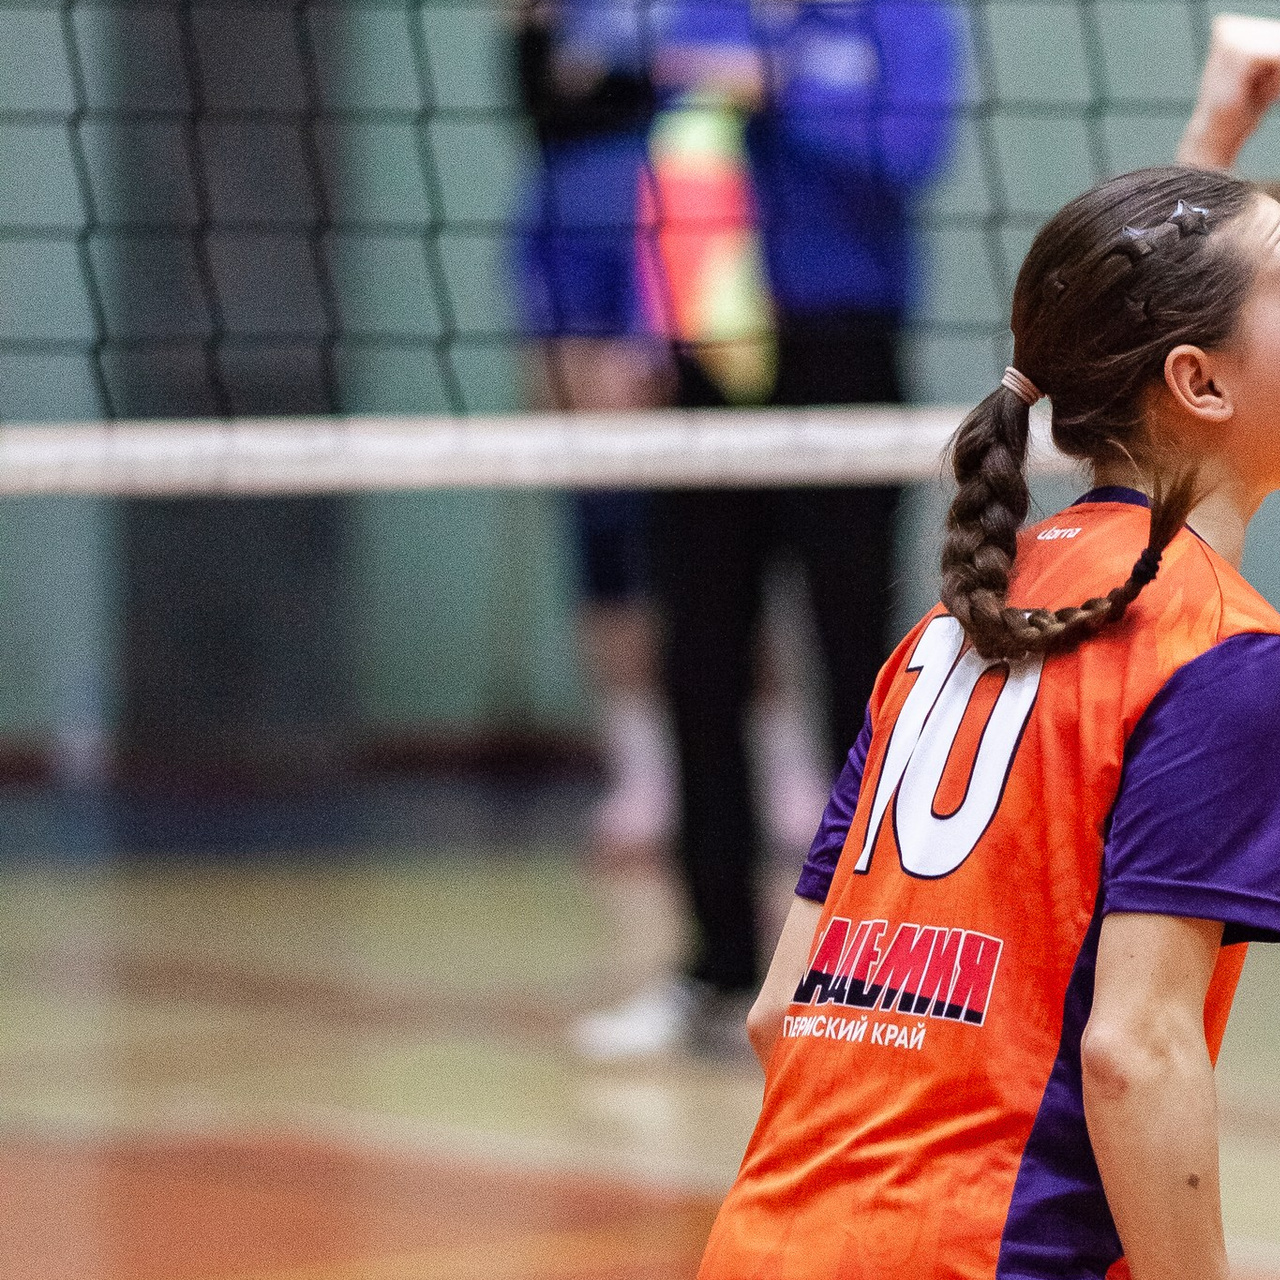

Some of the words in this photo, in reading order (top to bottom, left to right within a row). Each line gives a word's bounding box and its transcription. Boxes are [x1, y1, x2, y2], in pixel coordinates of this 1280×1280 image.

[853, 612, 1045, 880] 10
[792, 916, 1004, 1027] АДЕМИЯ
[783, 1015, 868, 1042] ПЕРМСКИЙ
[871, 1022, 926, 1050] КРАЙ
